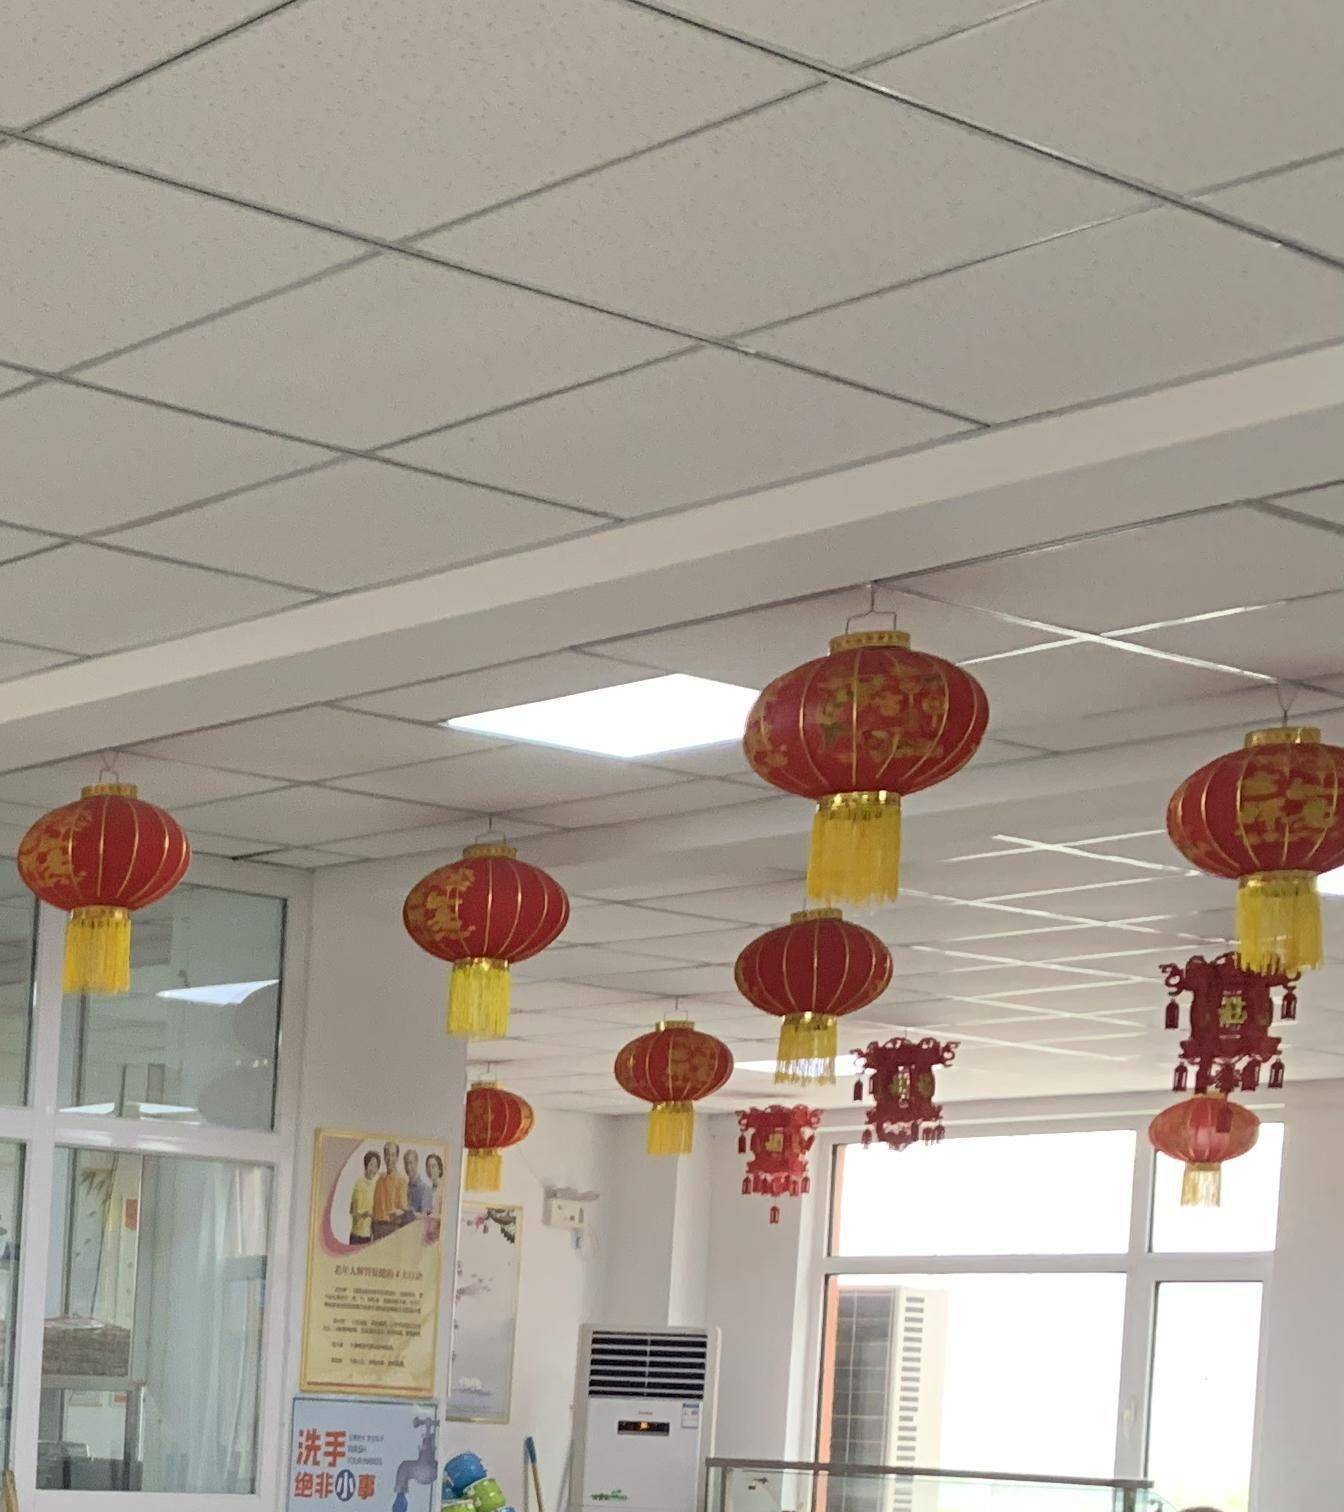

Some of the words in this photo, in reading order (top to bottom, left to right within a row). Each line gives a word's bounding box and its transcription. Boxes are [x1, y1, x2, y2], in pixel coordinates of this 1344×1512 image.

[296, 1428, 346, 1467] 洗手
[294, 1470, 376, 1501] 绝非小事
